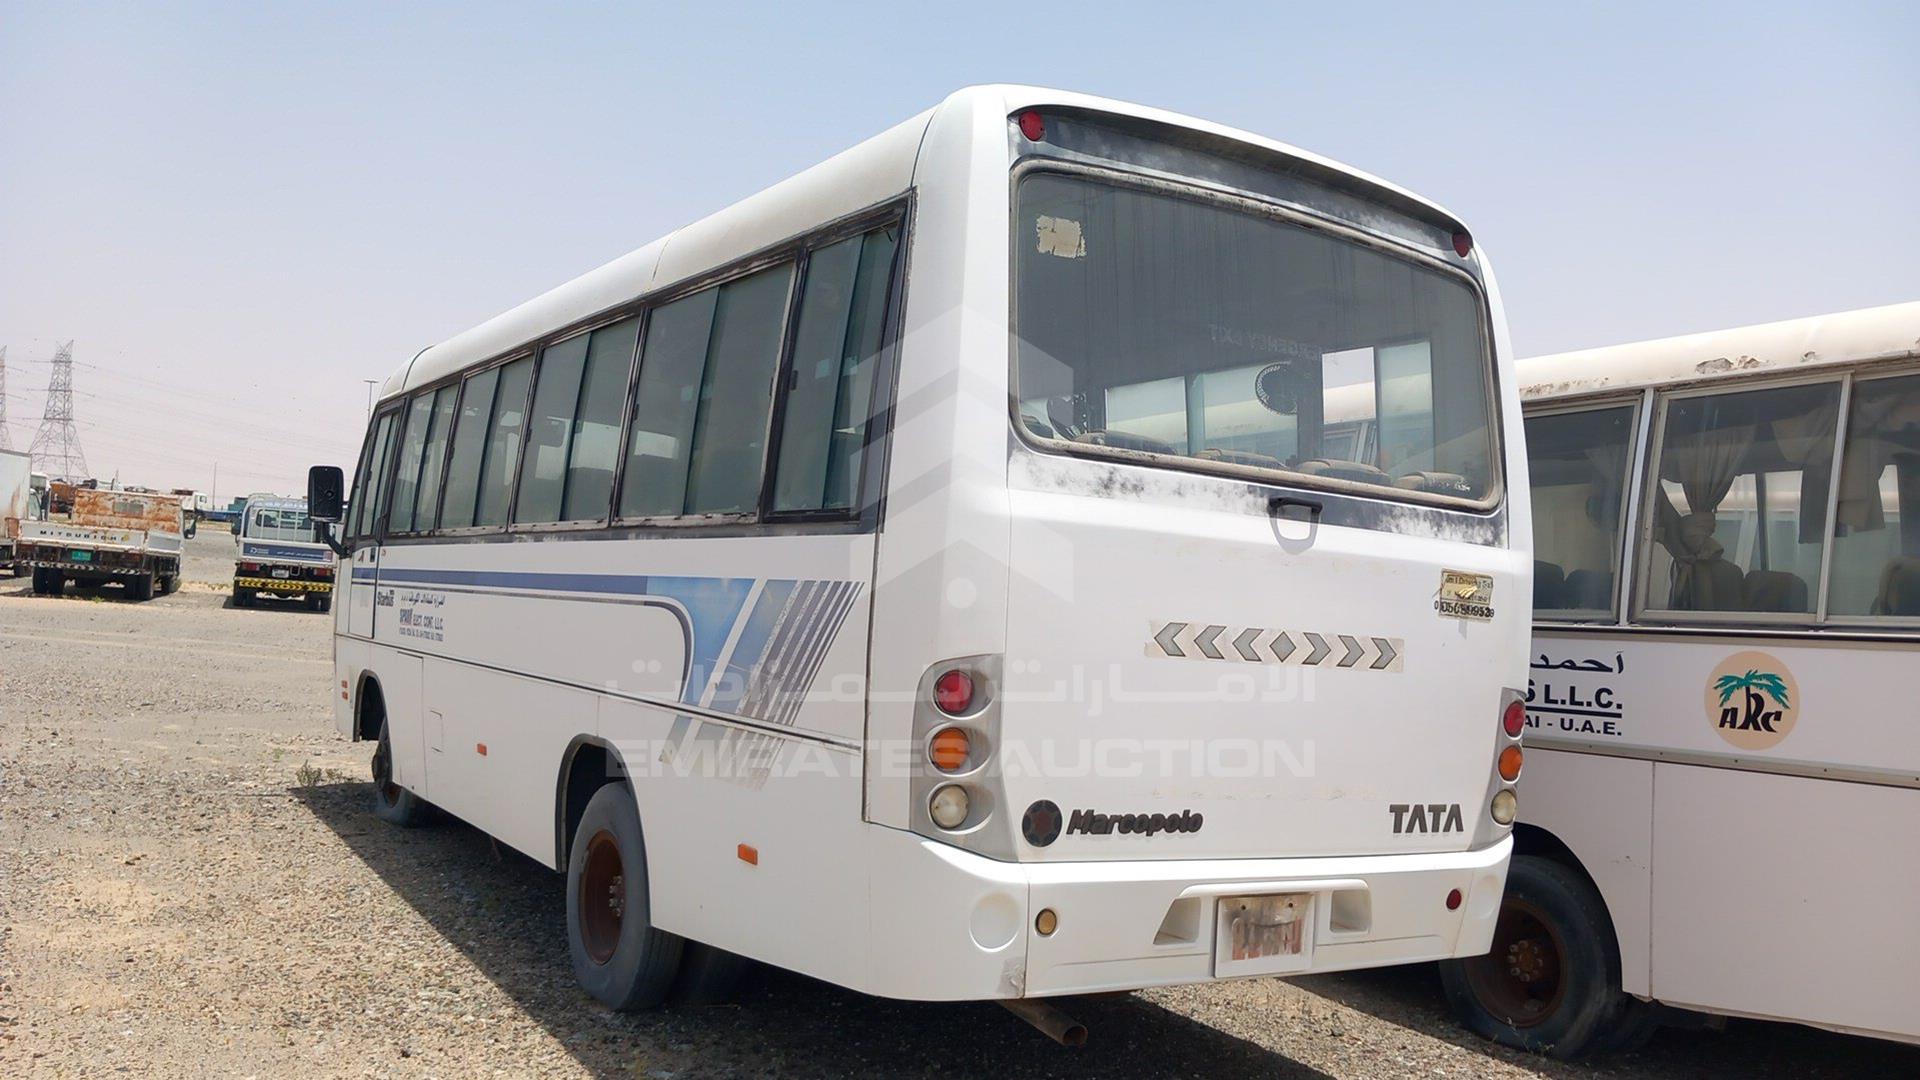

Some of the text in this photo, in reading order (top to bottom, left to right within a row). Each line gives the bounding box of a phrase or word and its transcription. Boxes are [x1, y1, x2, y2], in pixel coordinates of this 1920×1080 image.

[1544, 684, 1622, 709] L.L.C.
[1719, 686, 1782, 732] ARC
[1560, 717, 1622, 736] U.A.E.
[1066, 809, 1203, 837] Marcopolo
[1389, 804, 1464, 833] TATA
